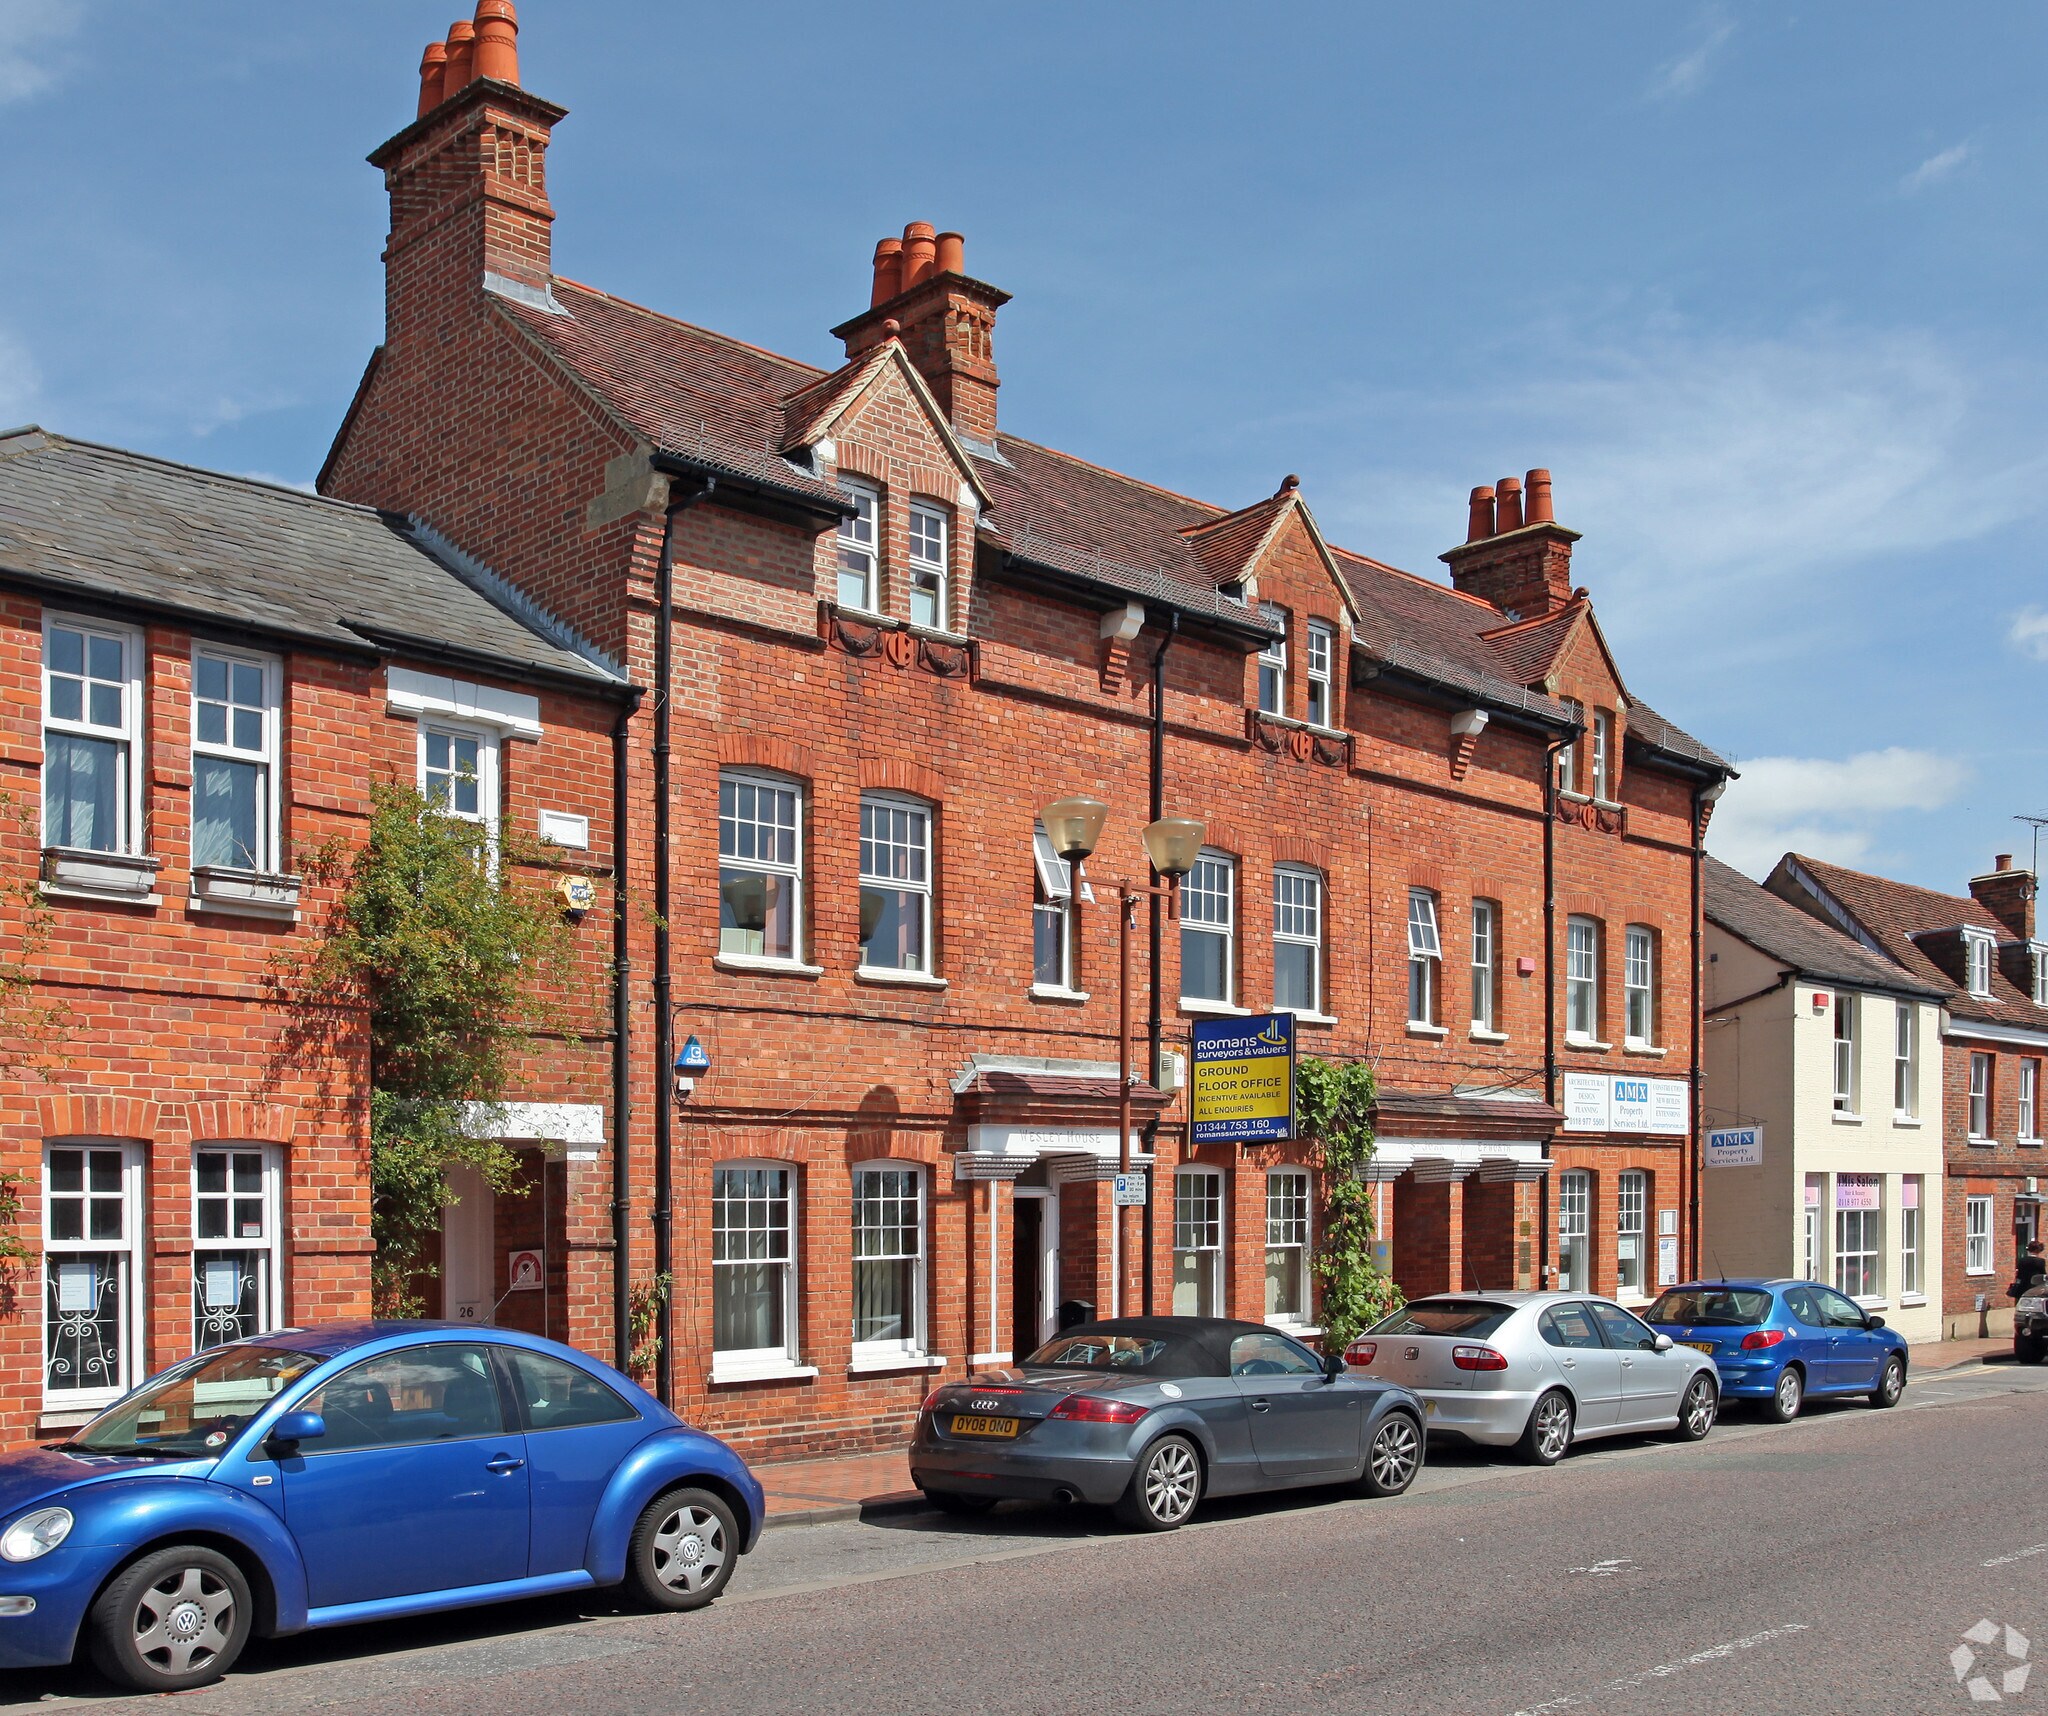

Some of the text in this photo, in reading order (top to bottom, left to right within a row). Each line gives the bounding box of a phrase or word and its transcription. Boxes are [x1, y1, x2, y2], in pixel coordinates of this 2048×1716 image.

[1197, 1045, 1287, 1059] surveyors & valuers
[1198, 1065, 1249, 1077] GROUND
[1198, 1077, 1281, 1091] FLOOR OFFICE
[1198, 1091, 1281, 1102] INCENTIVE AVAILABLE
[1616, 1083, 1647, 1100] AMX
[1199, 1105, 1254, 1115] ALL ENQUIRIES
[1619, 1105, 1644, 1117] Property
[1196, 1119, 1270, 1132] 01344 753 160
[1614, 1119, 1649, 1129] Services Ltd.
[1196, 1127, 1287, 1139] romanssurveyors.co.uk
[1713, 1132, 1753, 1146] AMX
[1717, 1148, 1748, 1156] Property
[1856, 1175, 1878, 1187] Salon
[460, 1306, 474, 1317] 26
[956, 1417, 986, 1431] OY08
